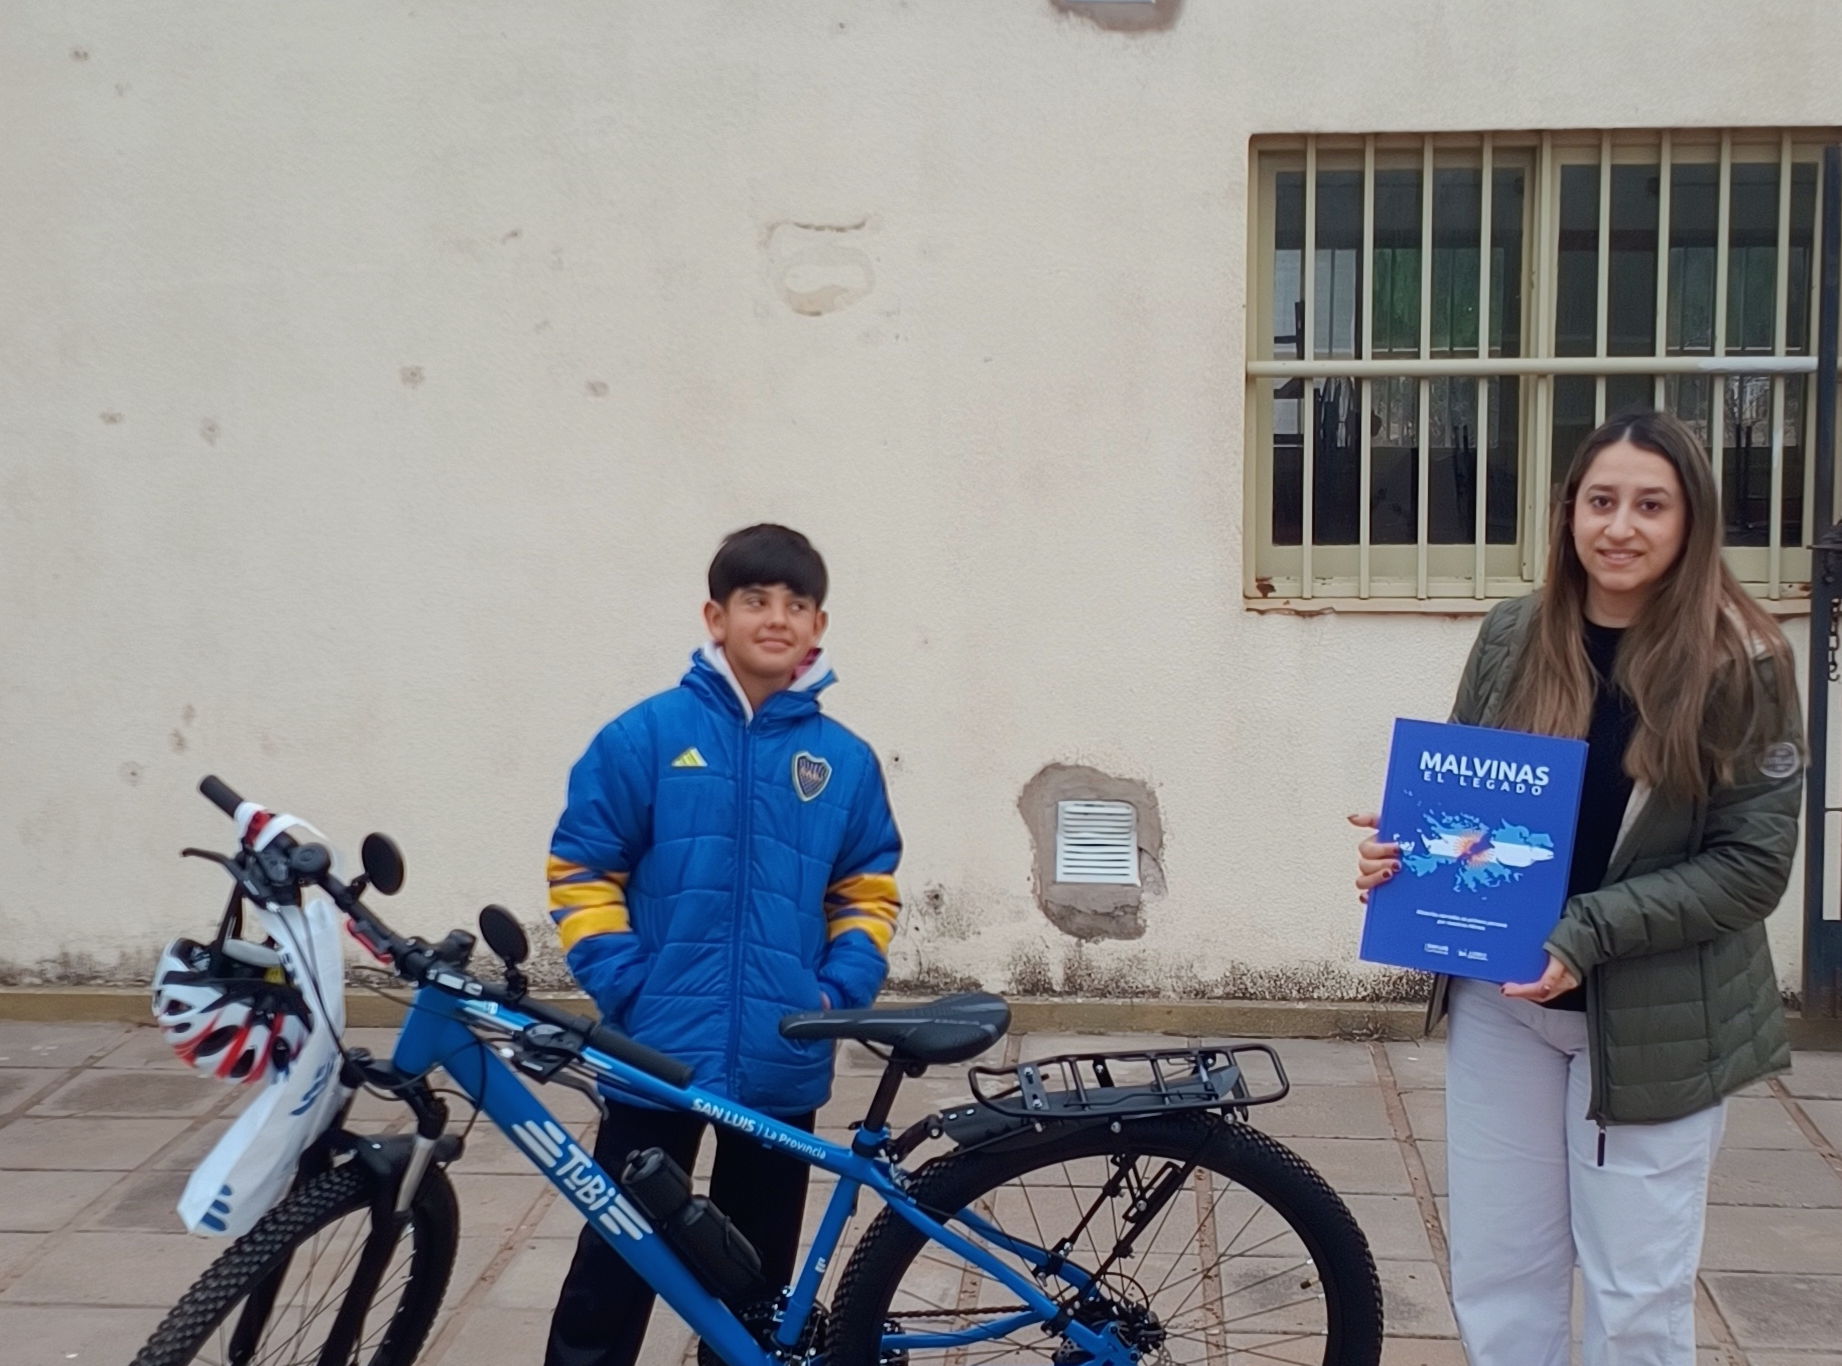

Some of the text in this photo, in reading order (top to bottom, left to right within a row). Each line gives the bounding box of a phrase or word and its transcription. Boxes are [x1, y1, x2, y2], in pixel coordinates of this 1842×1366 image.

[1419, 750, 1550, 786] MALVINAS
[1423, 770, 1542, 796] EL LEGADO
[690, 1097, 724, 1120] SAN
[723, 1110, 757, 1133] LUIS
[779, 1132, 827, 1160] Provincia
